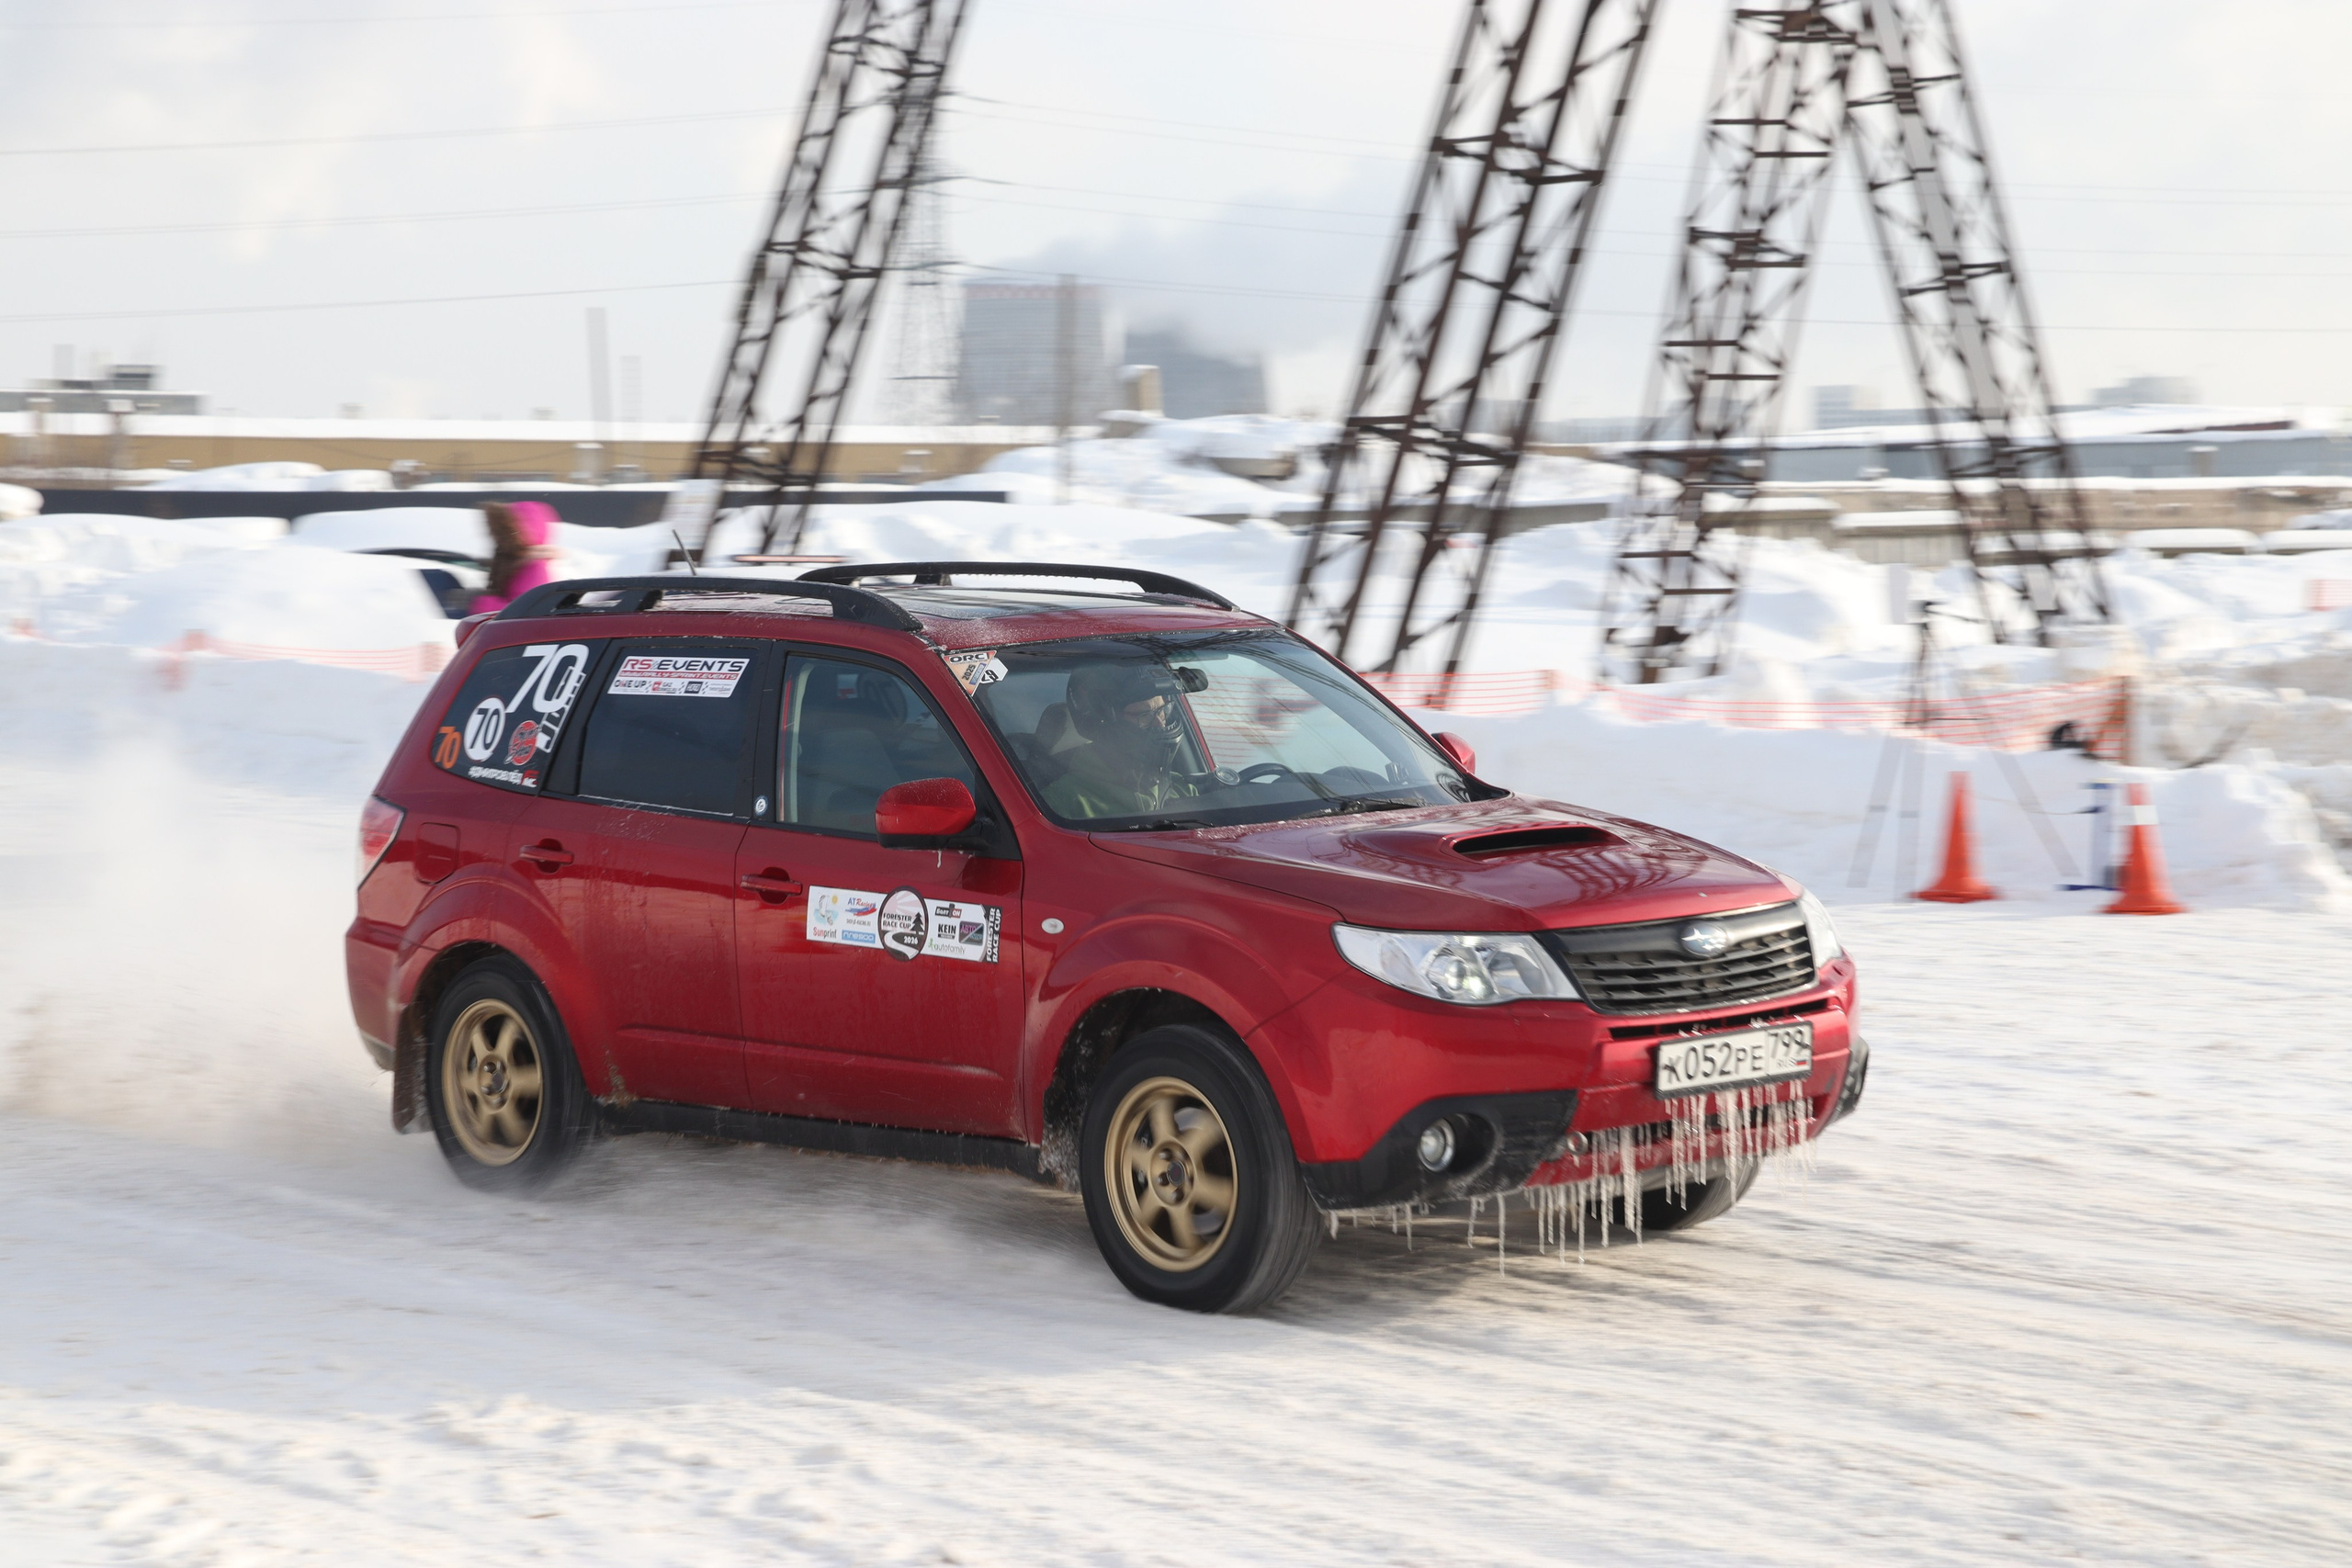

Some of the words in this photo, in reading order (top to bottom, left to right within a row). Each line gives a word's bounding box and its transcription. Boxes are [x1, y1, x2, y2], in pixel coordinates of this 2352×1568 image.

[949, 653, 985, 663] ORC
[657, 660, 746, 672] EVENTS
[962, 663, 976, 681] 2025
[505, 644, 589, 714] 70
[634, 681, 647, 689] UP
[469, 707, 501, 751] 70
[435, 726, 462, 769] 70
[883, 913, 912, 922] FORESTER
[813, 927, 837, 939] Sunprint
[938, 923, 956, 935] KEIN
[987, 908, 995, 962] FORESTER
[903, 935, 919, 944] 2026
[933, 943, 967, 955] autofamily
[1768, 1027, 1808, 1058] 799
